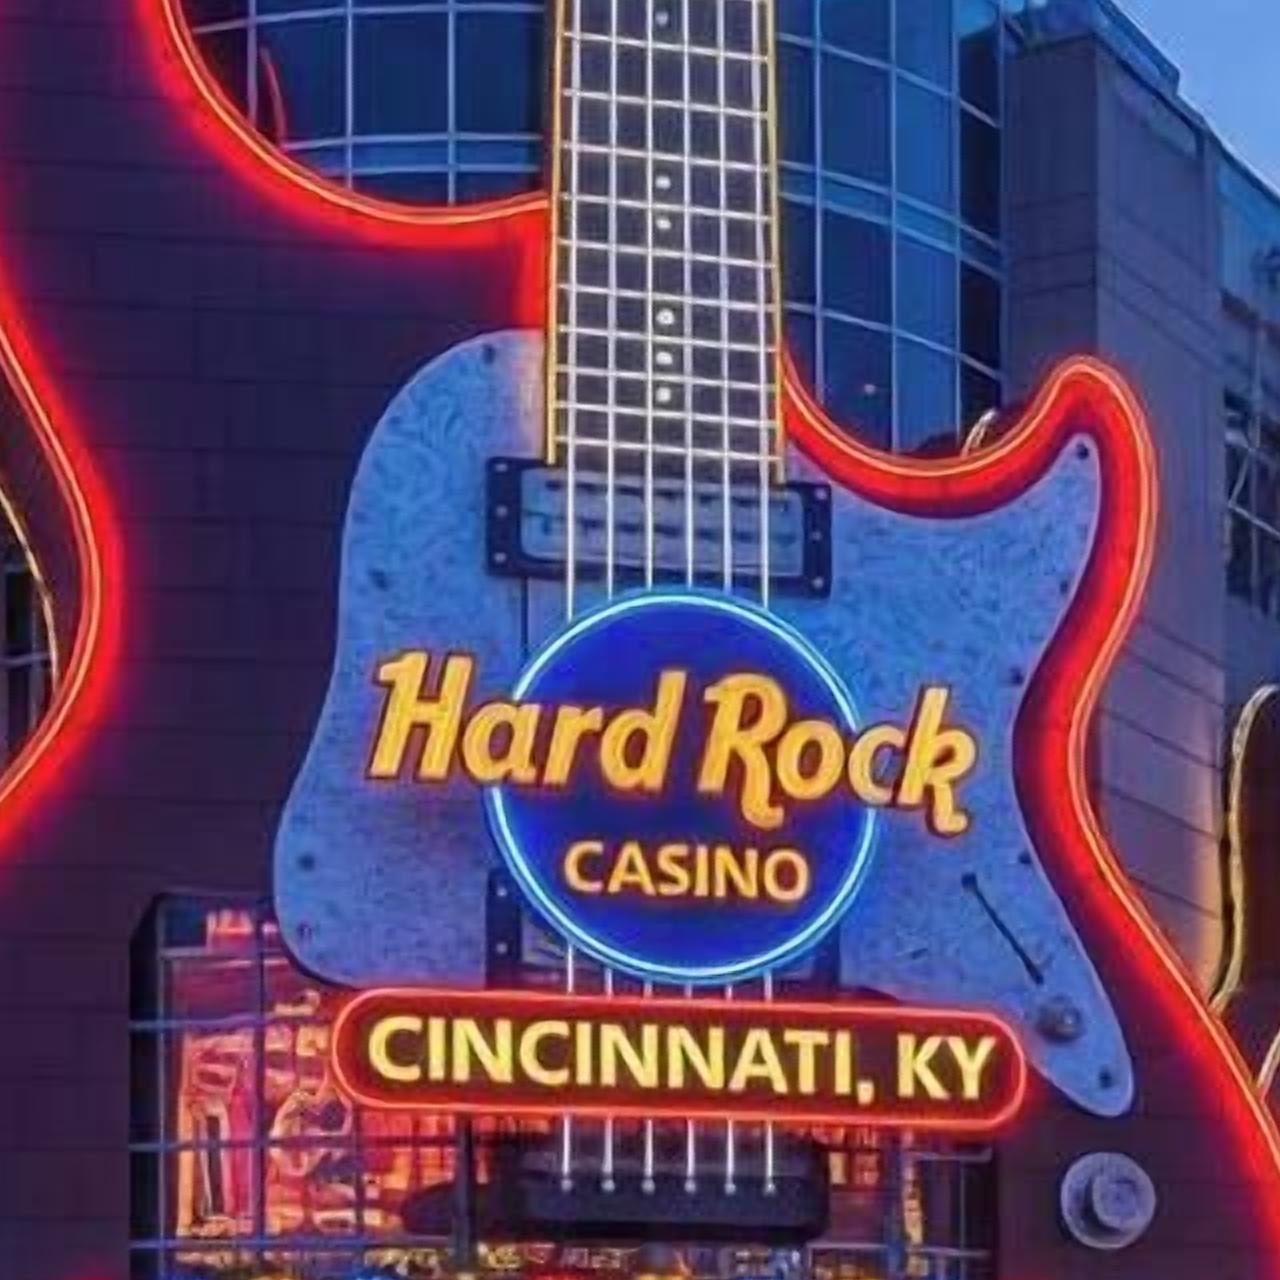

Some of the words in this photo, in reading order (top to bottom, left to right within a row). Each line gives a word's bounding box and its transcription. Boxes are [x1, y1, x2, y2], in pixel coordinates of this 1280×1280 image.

[368, 650, 687, 792] Hard
[696, 672, 977, 835] Rock
[563, 840, 810, 902] CASINO
[368, 1015, 875, 1104] CINCINNATI,
[896, 1036, 996, 1100] KY
